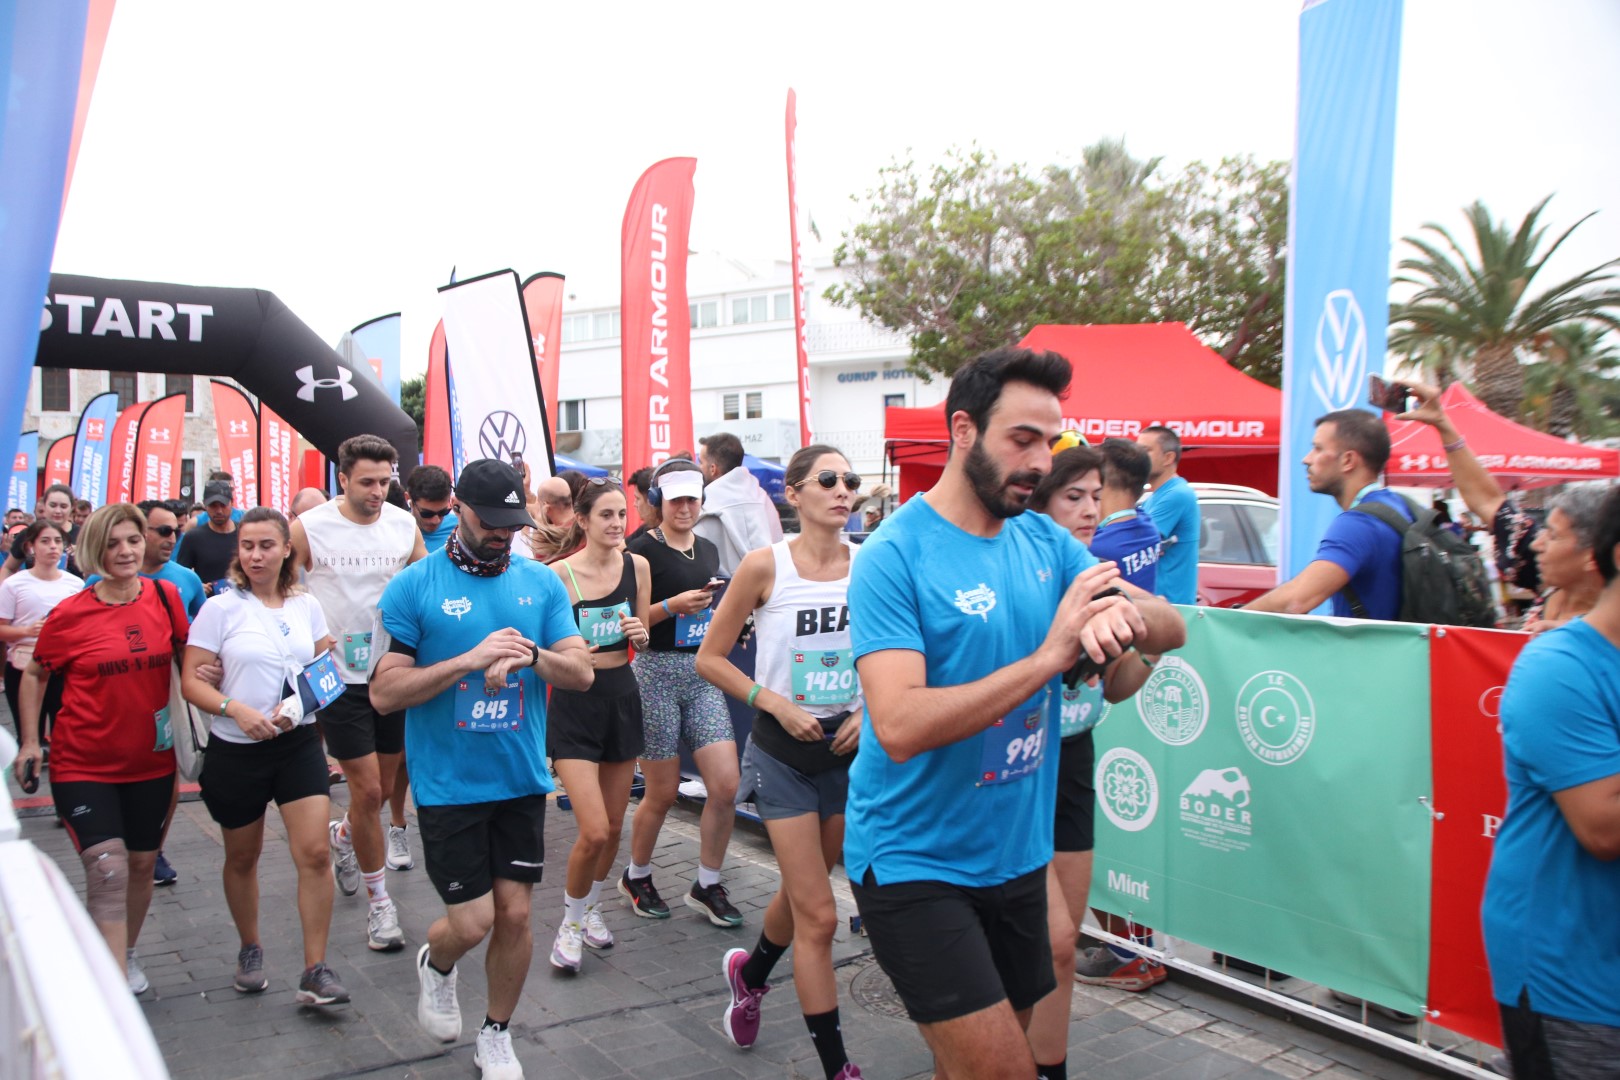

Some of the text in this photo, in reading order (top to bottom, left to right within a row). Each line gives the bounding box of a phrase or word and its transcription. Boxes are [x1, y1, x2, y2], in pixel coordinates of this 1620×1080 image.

[650, 203, 669, 388] ARMOUR
[837, 370, 878, 383] GURUP
[1122, 542, 1161, 575] TEAM
[591, 620, 622, 638] 1196
[354, 647, 373, 661] 13
[319, 671, 338, 693] 922
[804, 669, 853, 691] 1420
[471, 699, 509, 719] 845
[1179, 797, 1252, 825] BODER
[1107, 869, 1150, 900] Mint
